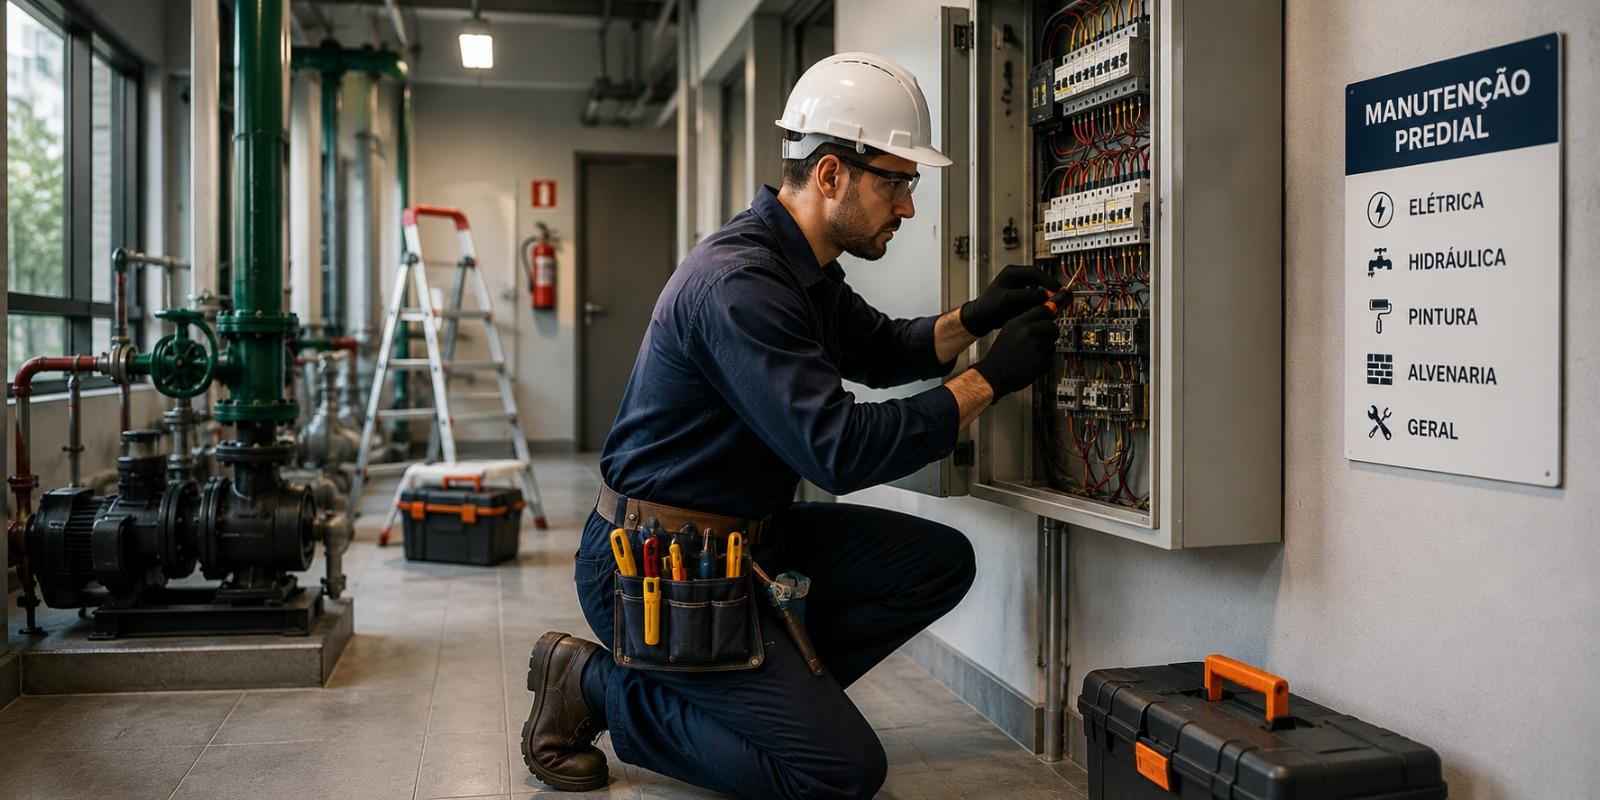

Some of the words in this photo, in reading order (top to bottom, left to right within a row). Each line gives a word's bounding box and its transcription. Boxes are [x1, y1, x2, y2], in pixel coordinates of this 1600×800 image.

[1365, 67, 1531, 126] MANUTENÇÃO
[1395, 114, 1490, 153] PREDIAL
[1409, 191, 1485, 216] ELÉTRICA
[1409, 247, 1507, 271] HIDRÁULICA
[1408, 307, 1478, 326] PINTURA
[1407, 363, 1498, 386] ALVENARIA
[1407, 418, 1459, 441] GERAL
